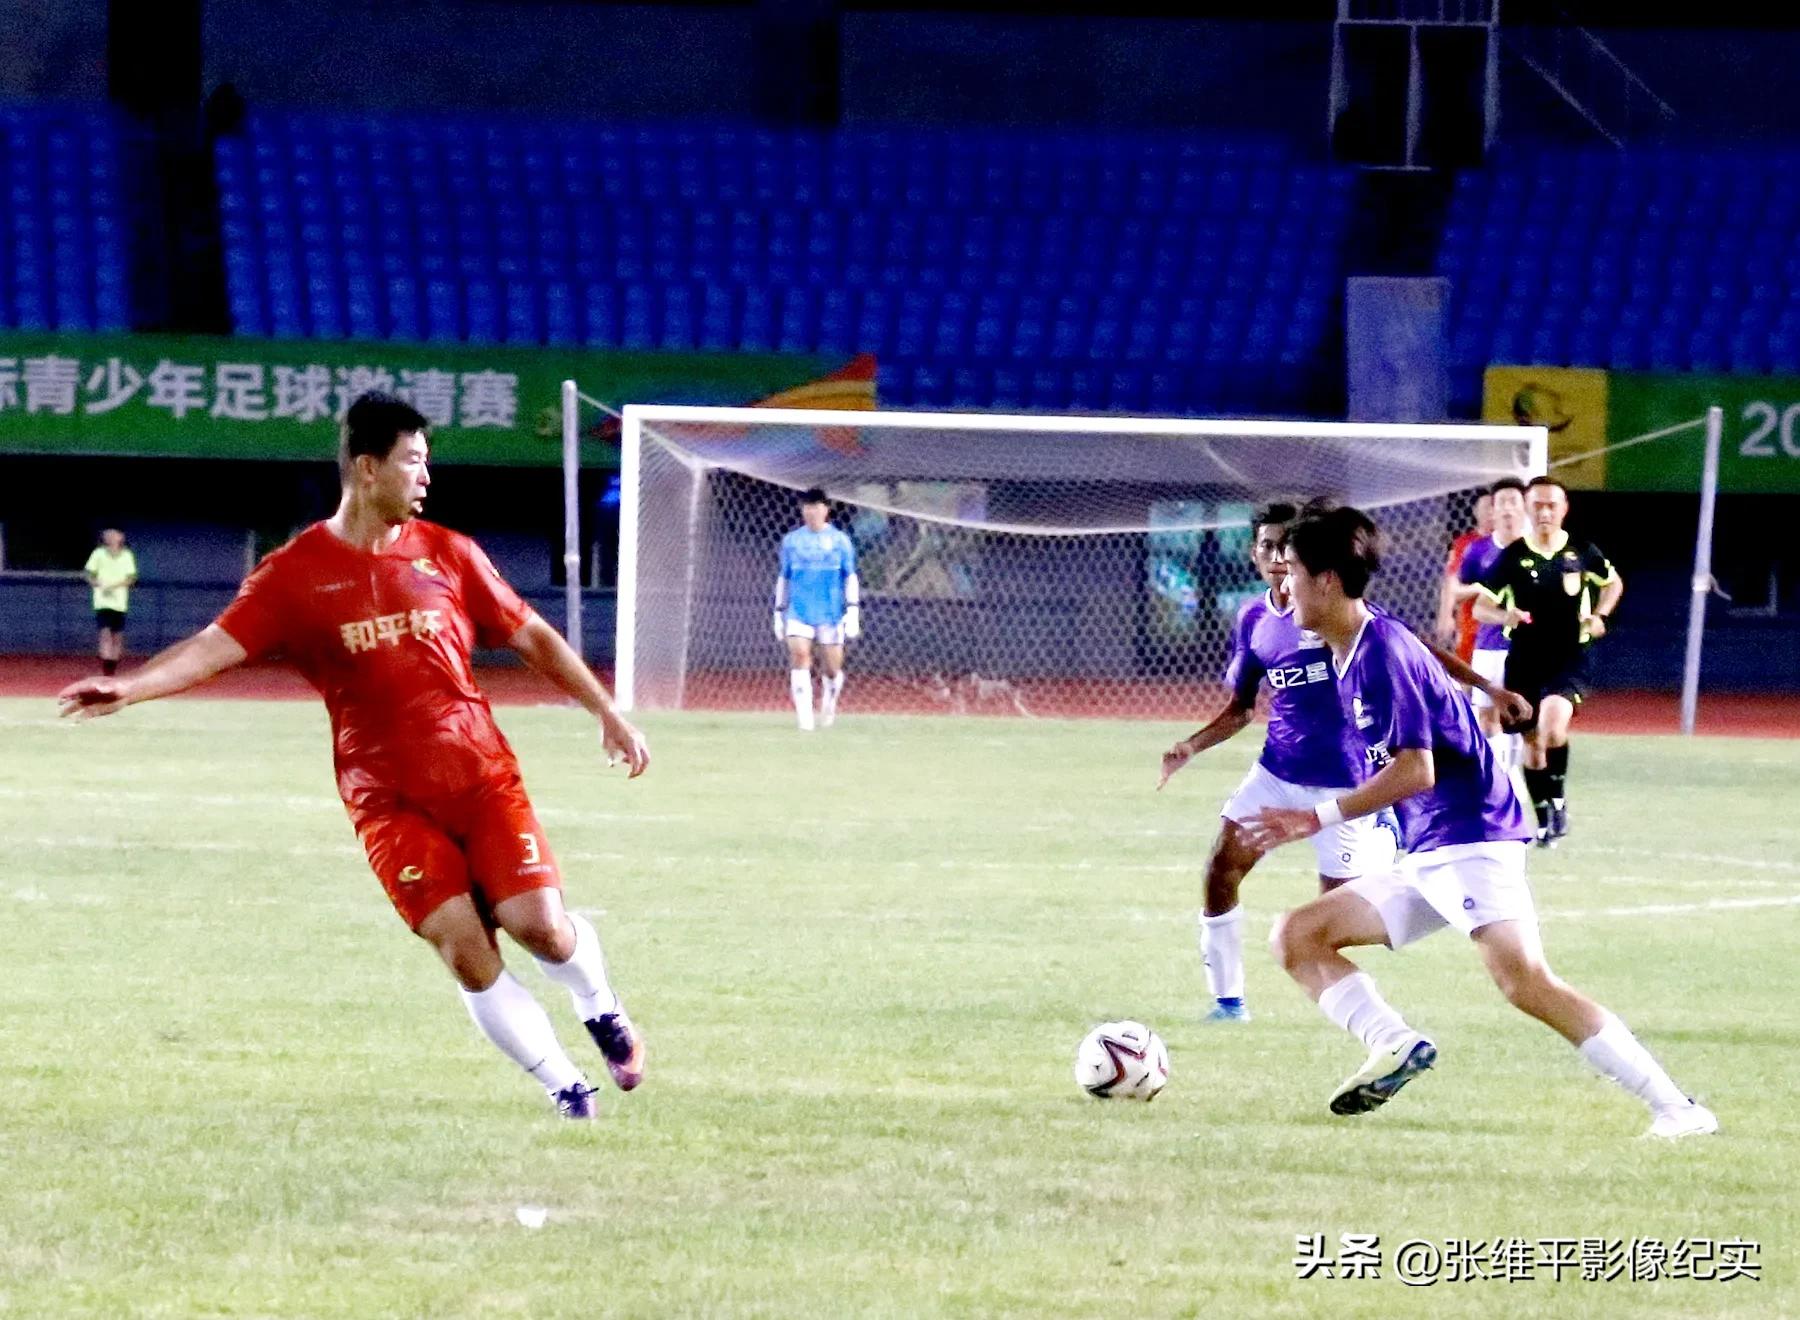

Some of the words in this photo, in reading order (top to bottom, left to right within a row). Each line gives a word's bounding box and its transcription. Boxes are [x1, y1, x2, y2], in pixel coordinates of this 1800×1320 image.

[340, 608, 445, 654] 和平杯
[517, 832, 542, 865] 3
